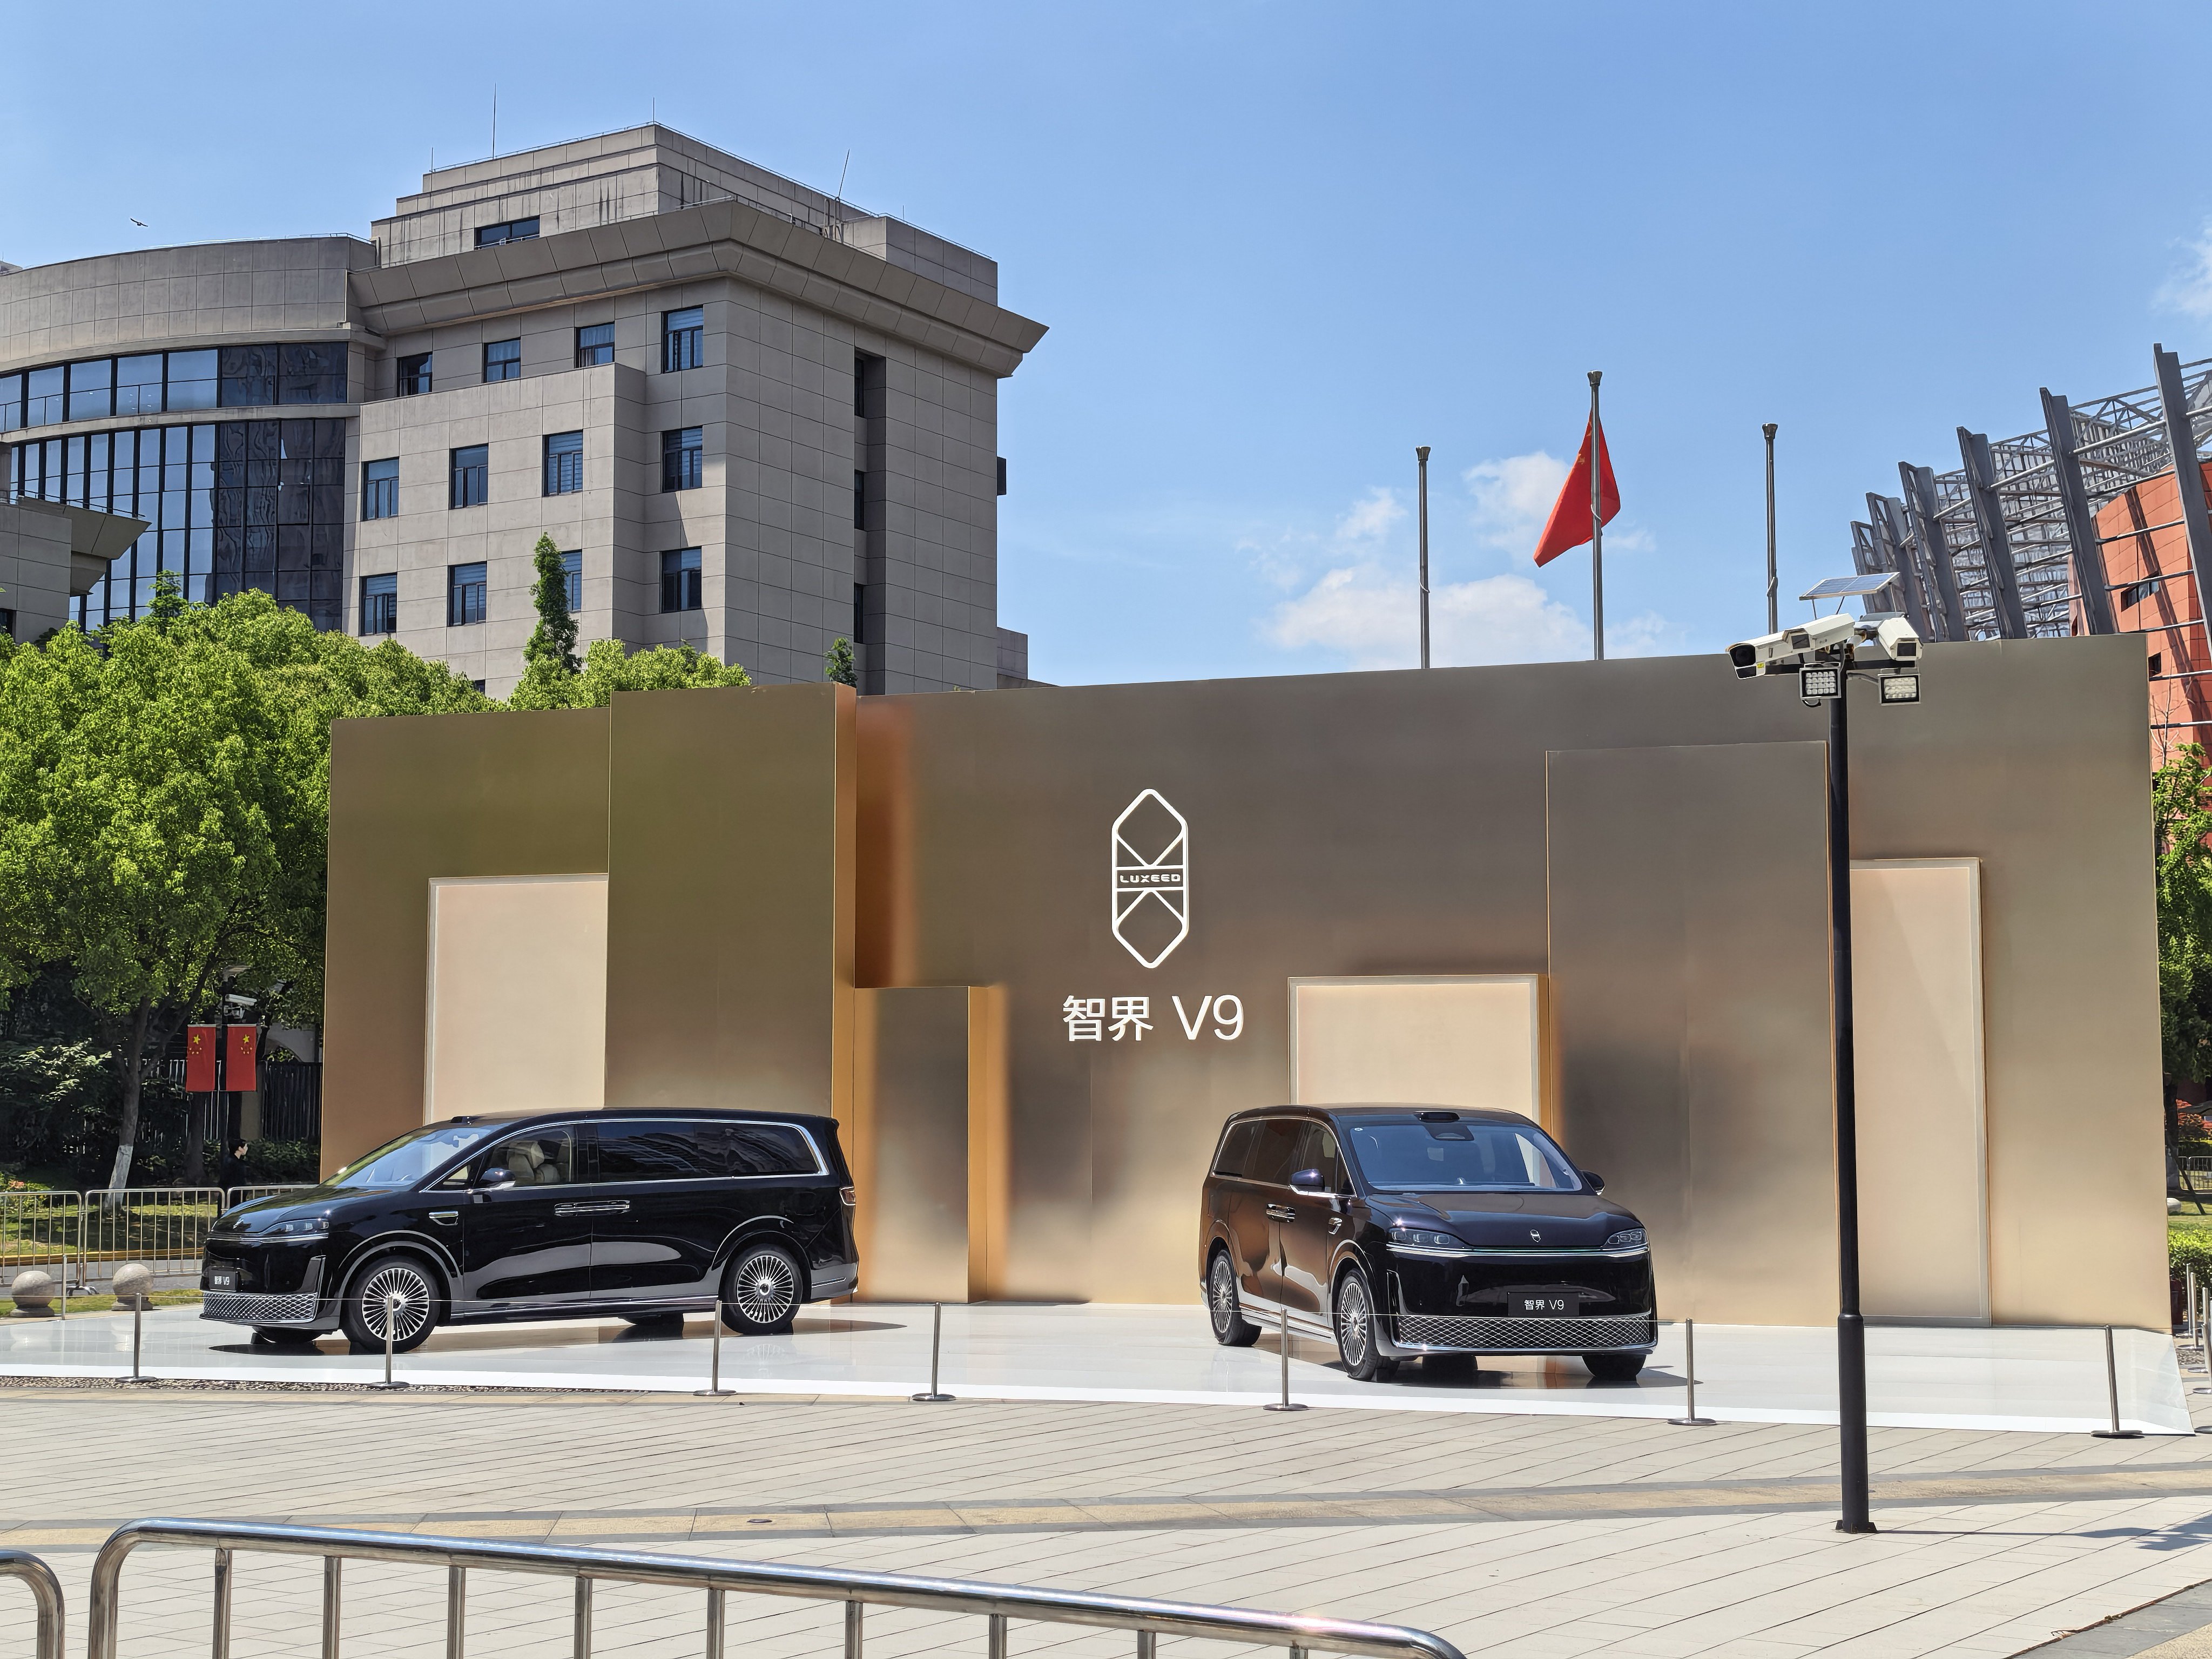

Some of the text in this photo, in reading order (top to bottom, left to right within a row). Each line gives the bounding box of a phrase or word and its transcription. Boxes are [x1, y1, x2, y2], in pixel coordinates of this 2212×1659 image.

[1120, 874, 1181, 884] LUXEED
[1062, 994, 1244, 1042] 智界 V9
[1524, 1299, 1564, 1310] 智界 V9
